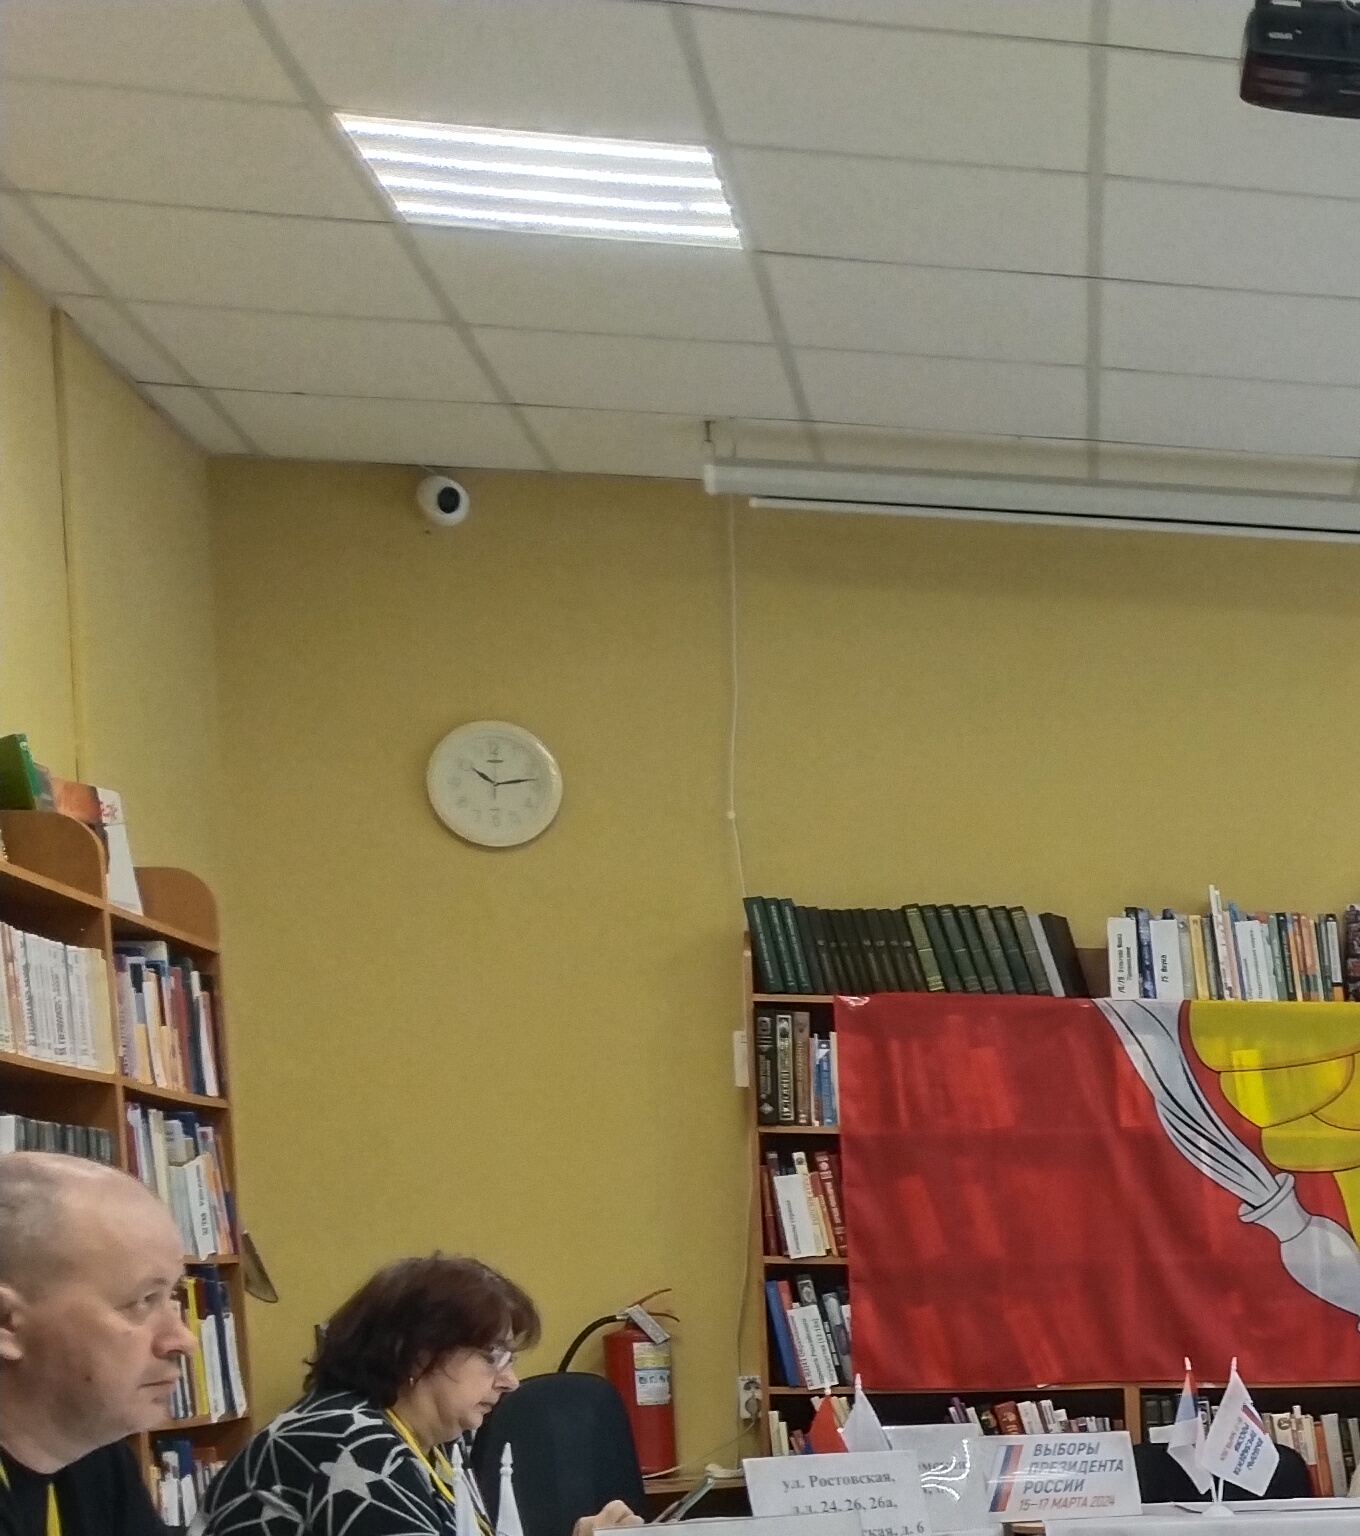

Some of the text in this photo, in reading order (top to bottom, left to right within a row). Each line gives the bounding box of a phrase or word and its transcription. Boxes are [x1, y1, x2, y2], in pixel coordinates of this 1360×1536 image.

[1033, 1442, 1100, 1457] ВЫБОРЫ
[1028, 1459, 1124, 1475] ПРЕЗИДЕНТА
[782, 1477, 805, 1493] ул.
[809, 1470, 896, 1487] Ростовская,
[1023, 1479, 1085, 1495] РОССИИ
[1051, 1497, 1089, 1510] МАРТА
[900, 1523, 915, 1536] д.
[916, 1520, 925, 1534] 6
